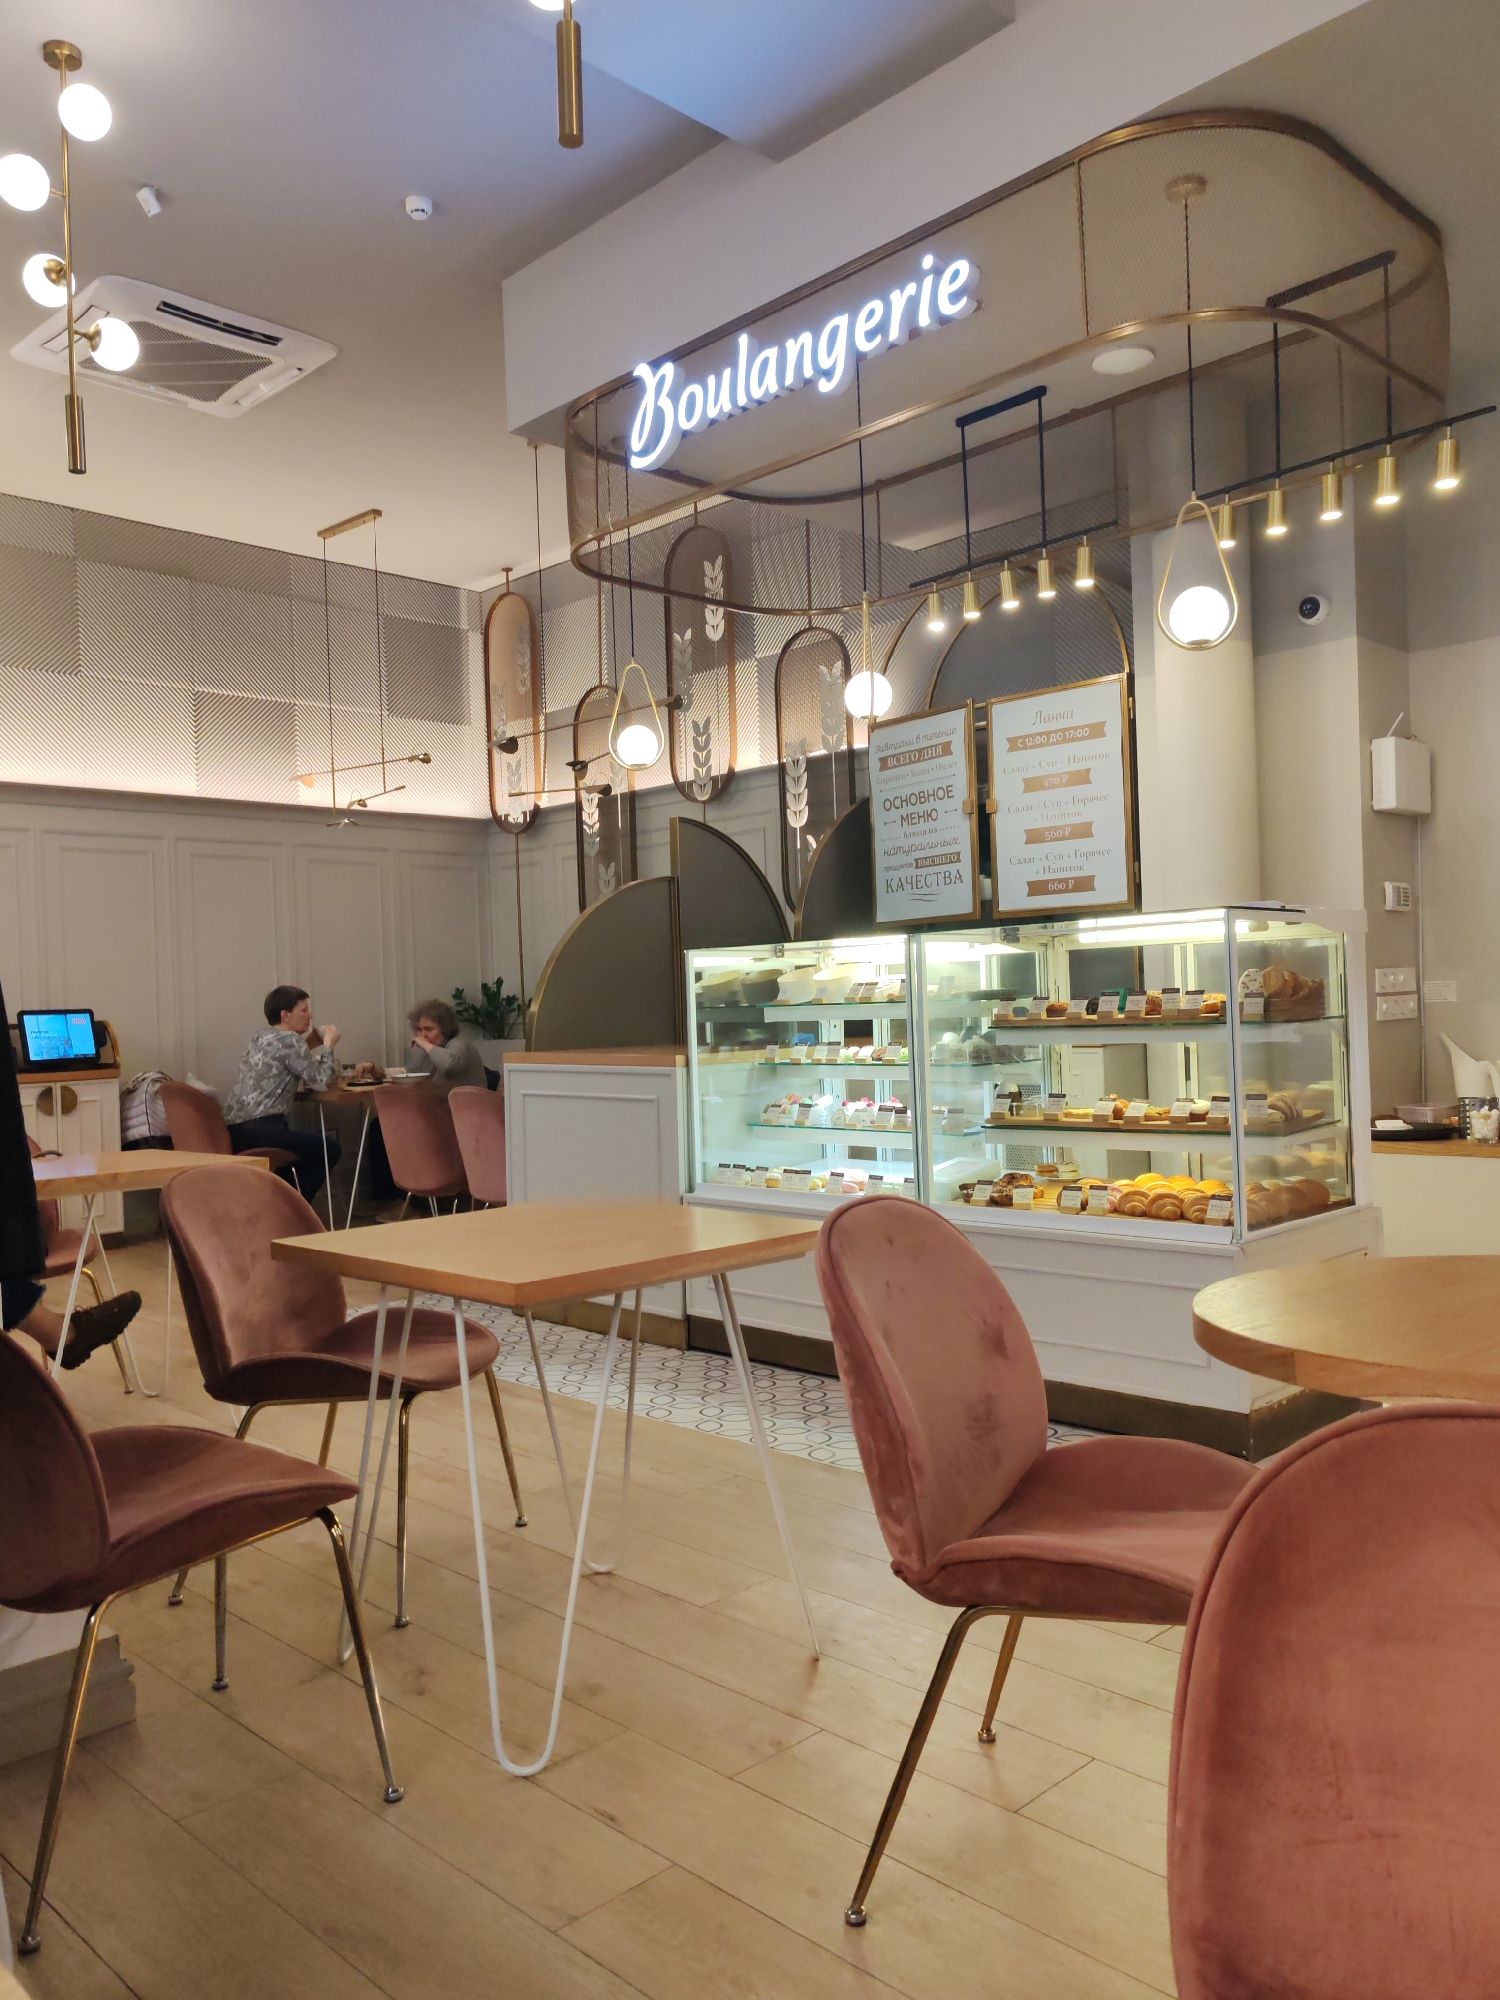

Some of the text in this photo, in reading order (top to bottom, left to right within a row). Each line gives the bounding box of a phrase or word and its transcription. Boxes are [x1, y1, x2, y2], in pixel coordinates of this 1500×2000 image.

[630, 254, 977, 469] Boulangerie
[1032, 709, 1074, 726] Ланчи
[875, 727, 958, 754] Завтраки в течение
[1017, 727, 1090, 748] С 12:00 ДО 17:00
[887, 744, 943, 768] ВСЕГО ДНЯ
[1003, 764, 1030, 776] Салат
[1038, 758, 1058, 773] Суп
[1067, 751, 1111, 765] Напиток
[910, 767, 930, 779] Каши
[935, 761, 958, 772] Омлет
[1043, 777, 1061, 788] 470
[883, 784, 955, 812] ОСНОВНОЕ
[1007, 803, 1035, 814] Салат
[1043, 798, 1062, 812] Суп
[1072, 793, 1109, 807] Горячее
[900, 808, 939, 828] МЕНЮ
[1040, 810, 1083, 822] Напиток
[903, 827, 938, 840] блюда из
[1045, 828, 1063, 841] 560
[883, 836, 960, 858] натуральных
[1009, 855, 1036, 866] Салат
[1045, 851, 1064, 865] Суп
[1074, 848, 1112, 862] Горячее
[883, 853, 958, 873] продуктов ВЫСШЕГО
[1042, 864, 1085, 875] Напиток
[885, 868, 964, 894] КАЧЕСТВА
[1048, 880, 1066, 891] 660
